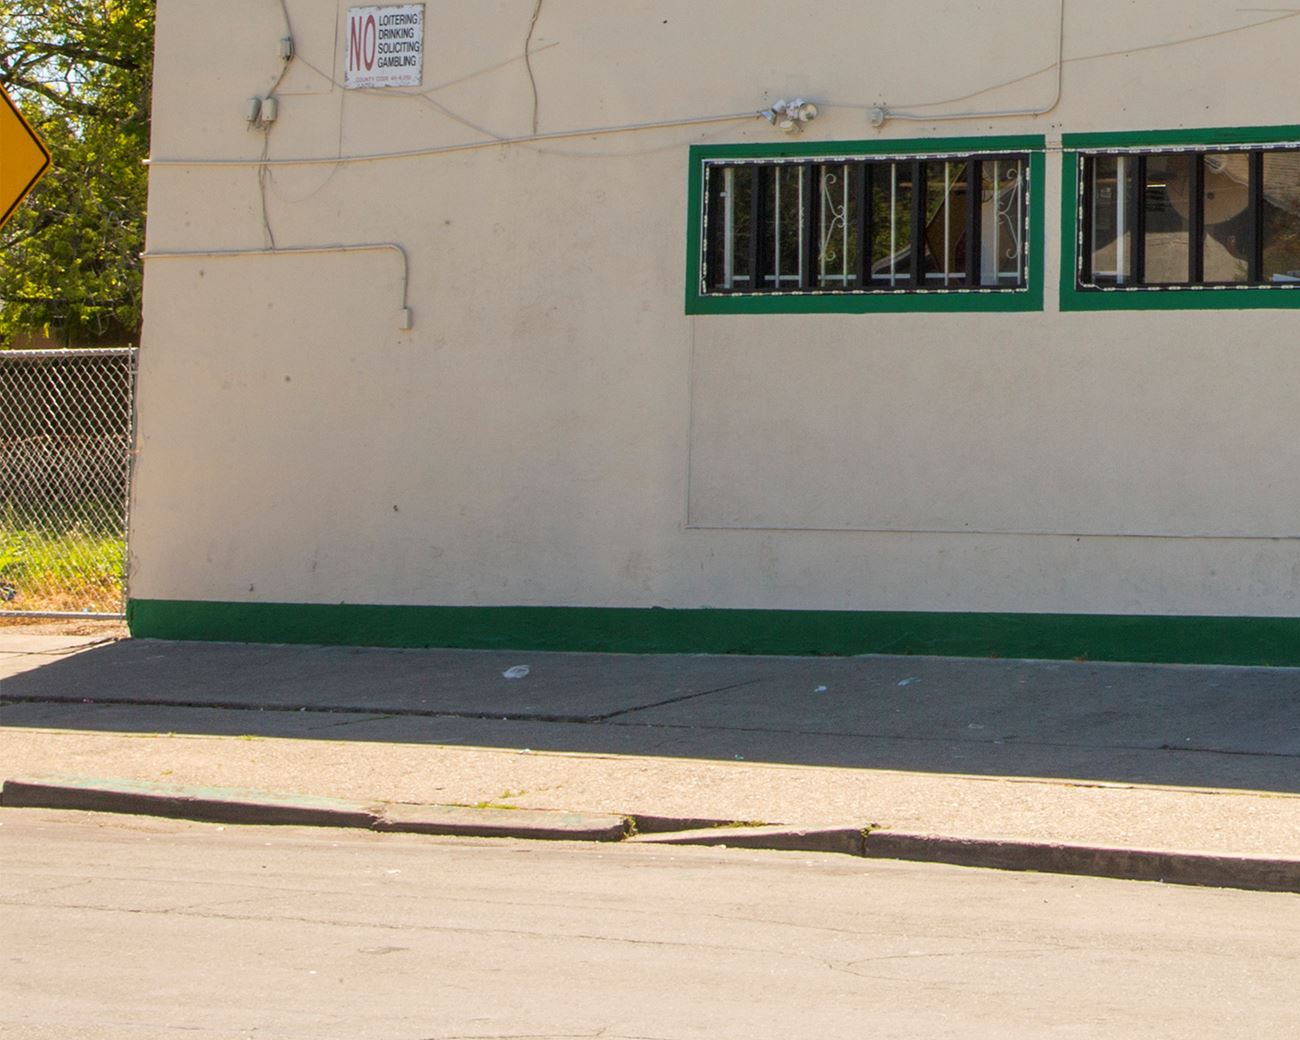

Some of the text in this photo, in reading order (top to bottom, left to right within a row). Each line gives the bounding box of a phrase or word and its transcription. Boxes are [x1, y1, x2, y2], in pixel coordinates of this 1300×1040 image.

[378, 13, 418, 26] LOITERING
[378, 27, 414, 40] DRINKING
[349, 14, 376, 72] NO
[377, 41, 420, 54] SOLICITING
[377, 55, 417, 68] GAMBLING
